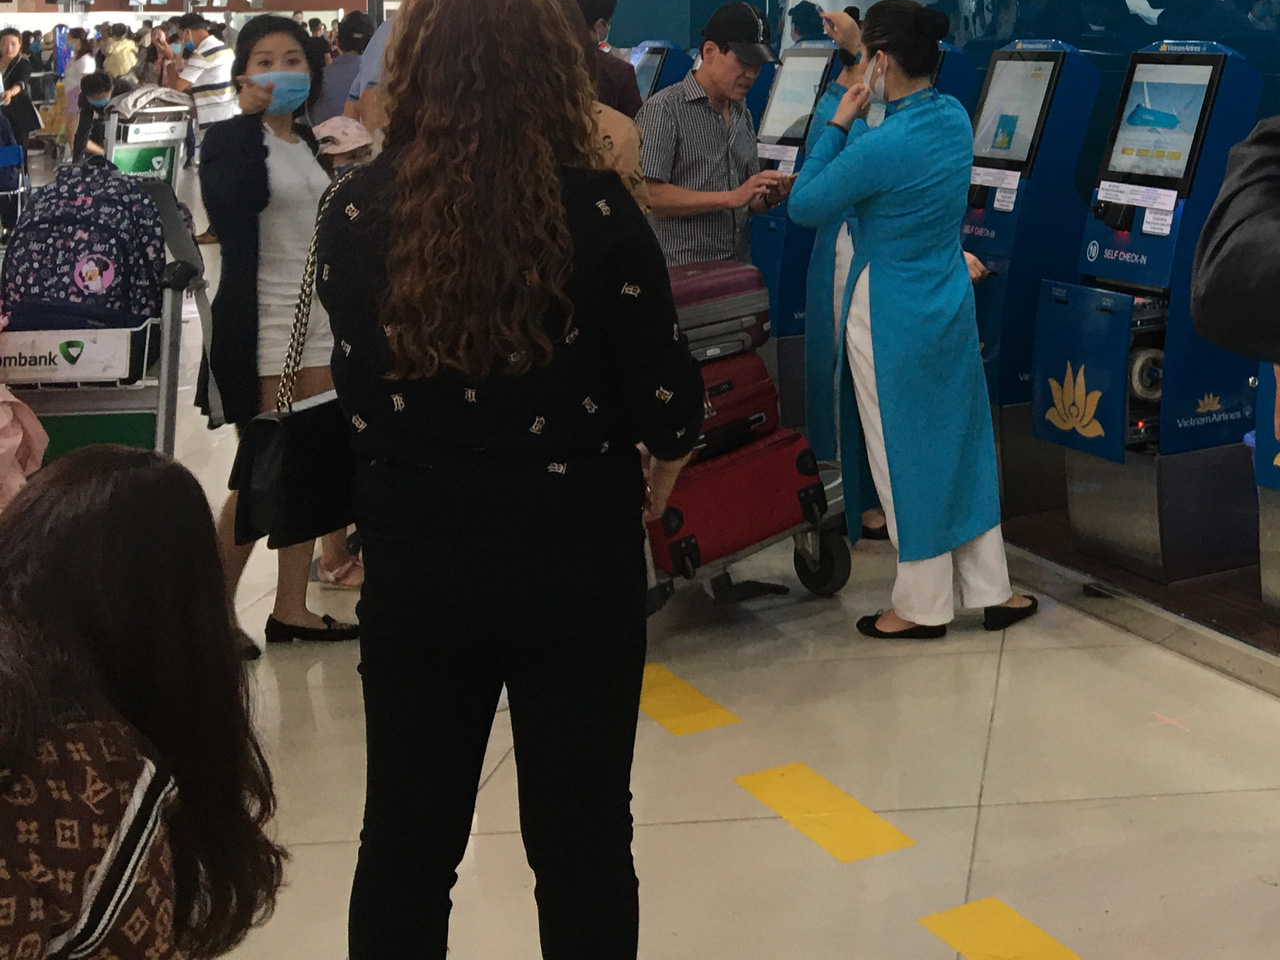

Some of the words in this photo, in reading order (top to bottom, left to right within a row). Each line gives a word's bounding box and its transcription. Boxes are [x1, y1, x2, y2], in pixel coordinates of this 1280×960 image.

[1103, 248, 1119, 260] SELF
[1118, 251, 1148, 265] CHECK-IN
[0, 351, 58, 367] mbank
[1177, 415, 1211, 428] Vietnam
[1211, 411, 1242, 423] Airlines
